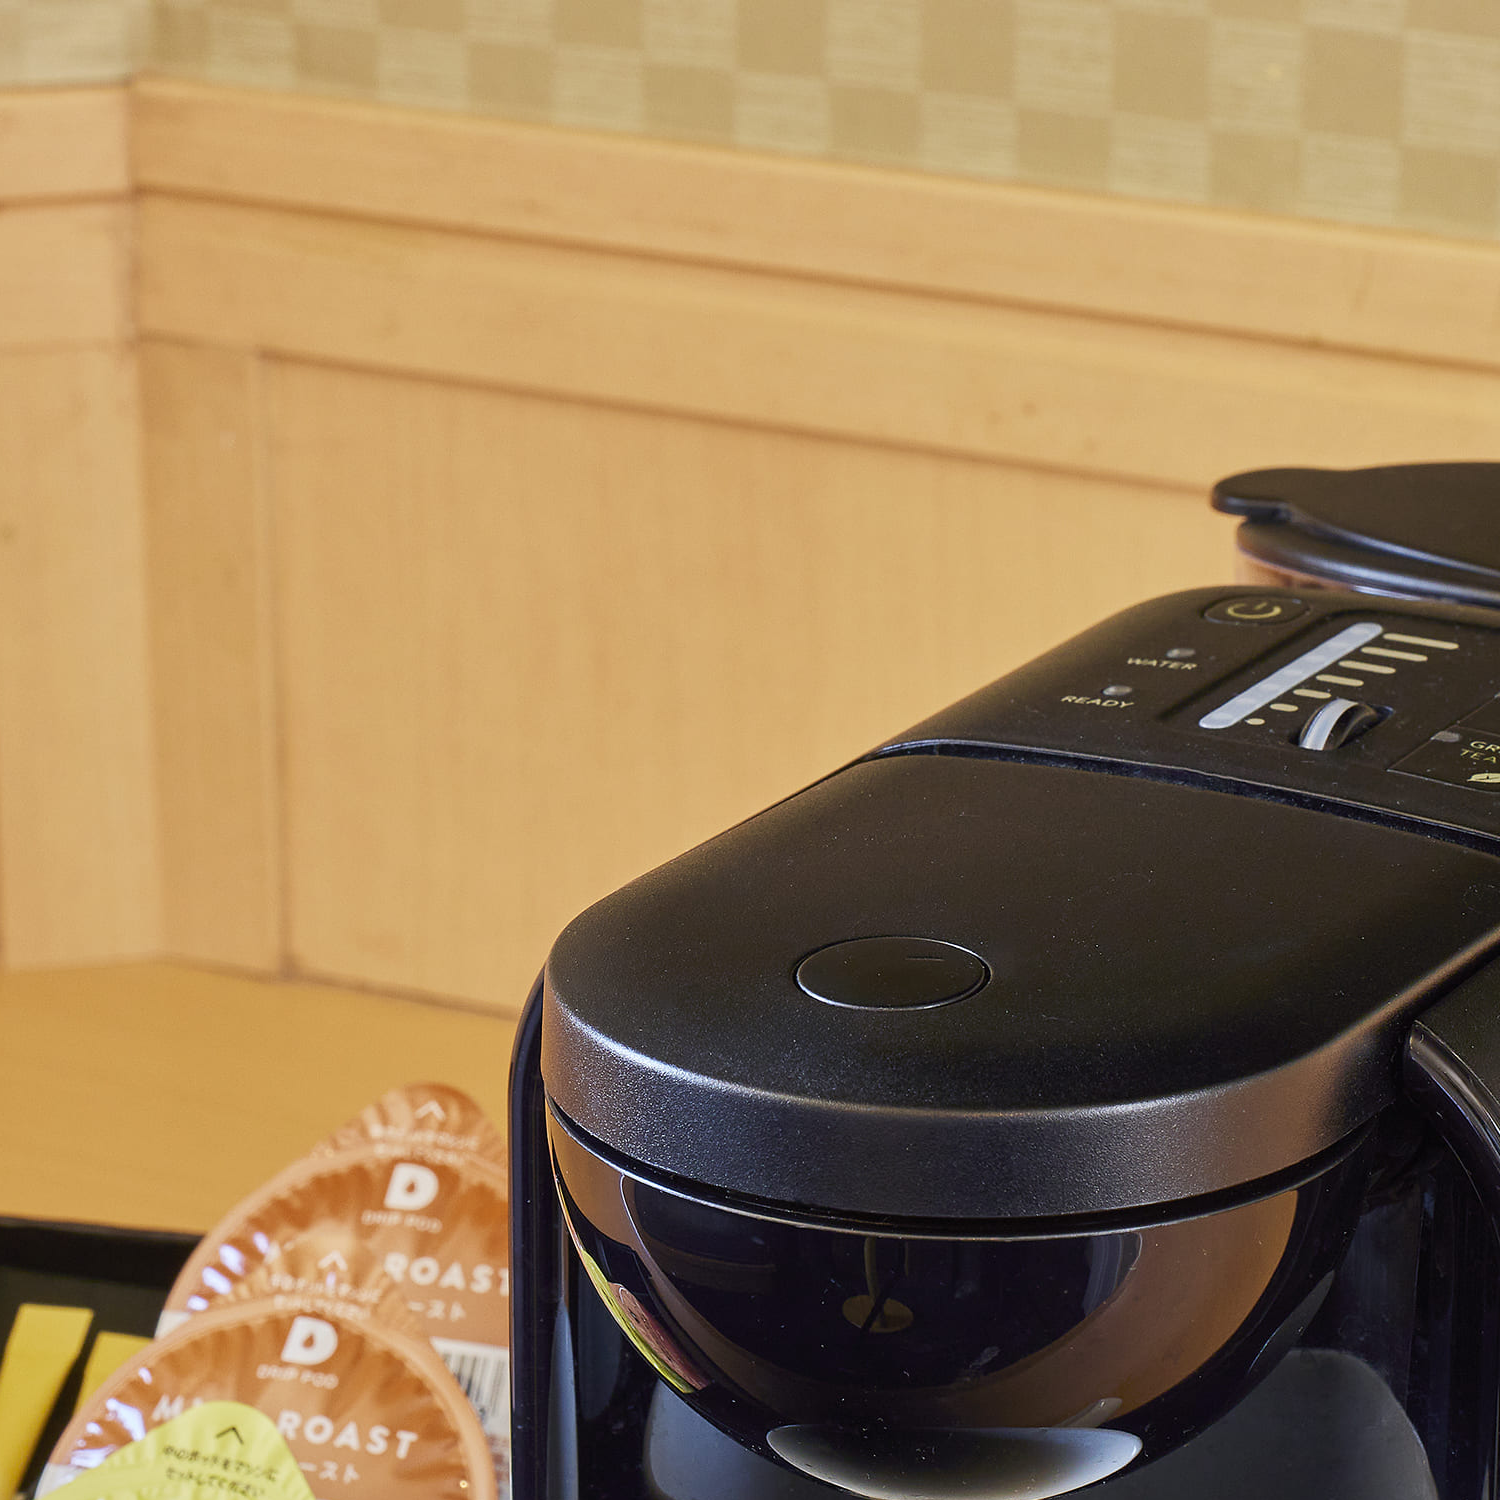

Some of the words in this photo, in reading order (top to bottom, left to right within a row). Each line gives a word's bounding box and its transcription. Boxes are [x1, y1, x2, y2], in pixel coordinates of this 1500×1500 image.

[1127, 657, 1198, 670] WATER
[1061, 695, 1135, 709] READY
[1460, 749, 1497, 764] TEA
[256, 1363, 299, 1381] DRIP
[300, 1368, 340, 1390] POD
[278, 1409, 419, 1460] ROAST
